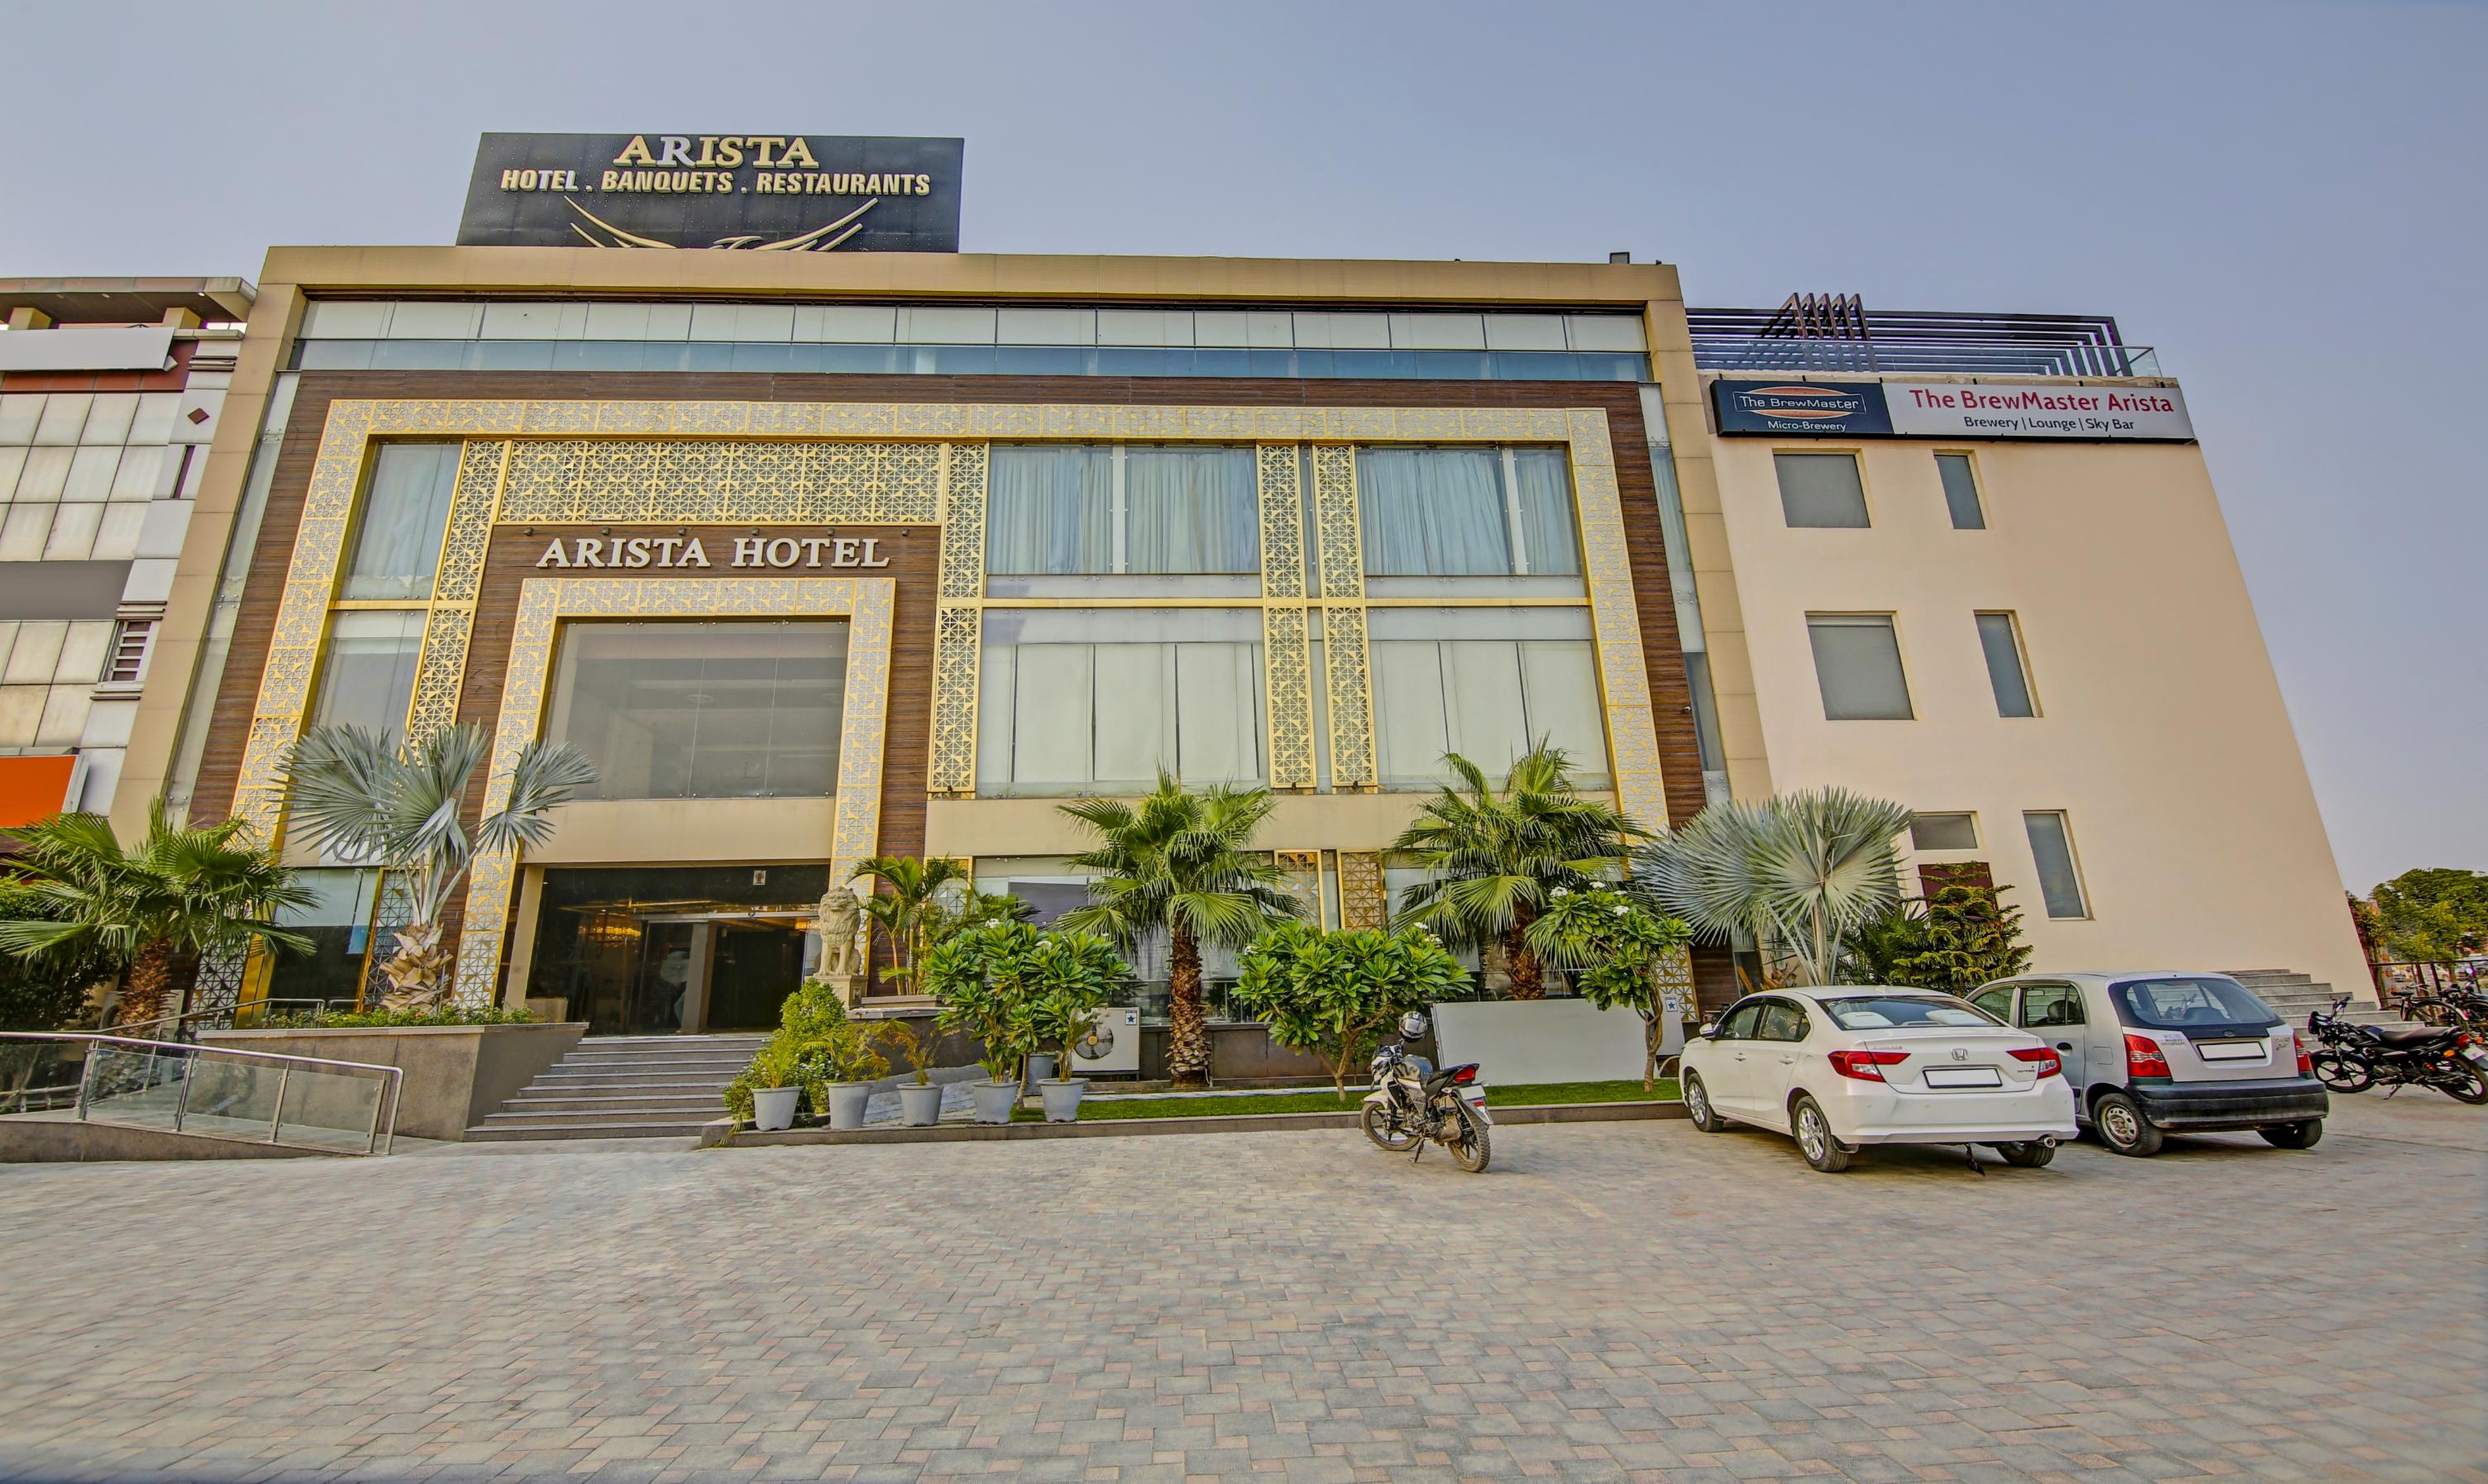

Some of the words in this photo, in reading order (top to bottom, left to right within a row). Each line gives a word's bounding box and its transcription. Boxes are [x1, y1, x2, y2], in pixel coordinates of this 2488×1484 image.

[613, 135, 819, 169] ARISTA
[500, 169, 580, 192] HOTEL
[600, 170, 734, 194] BANQUETS
[756, 172, 931, 196] RESTAURANTS
[1739, 395, 1765, 408] The
[1769, 398, 1859, 409] BrewMaster
[1908, 389, 1956, 408] The
[1960, 390, 2099, 411] BrewMaster
[2108, 393, 2175, 413] Arista
[1768, 420, 1847, 432] Micro-Brewery
[1963, 416, 2018, 431] Brewery
[2028, 418, 2077, 432] Lounge
[2084, 418, 2109, 432] Sky
[2112, 418, 2134, 430] Bar
[535, 537, 711, 568] ARISTA
[731, 537, 891, 568] HOTEL
